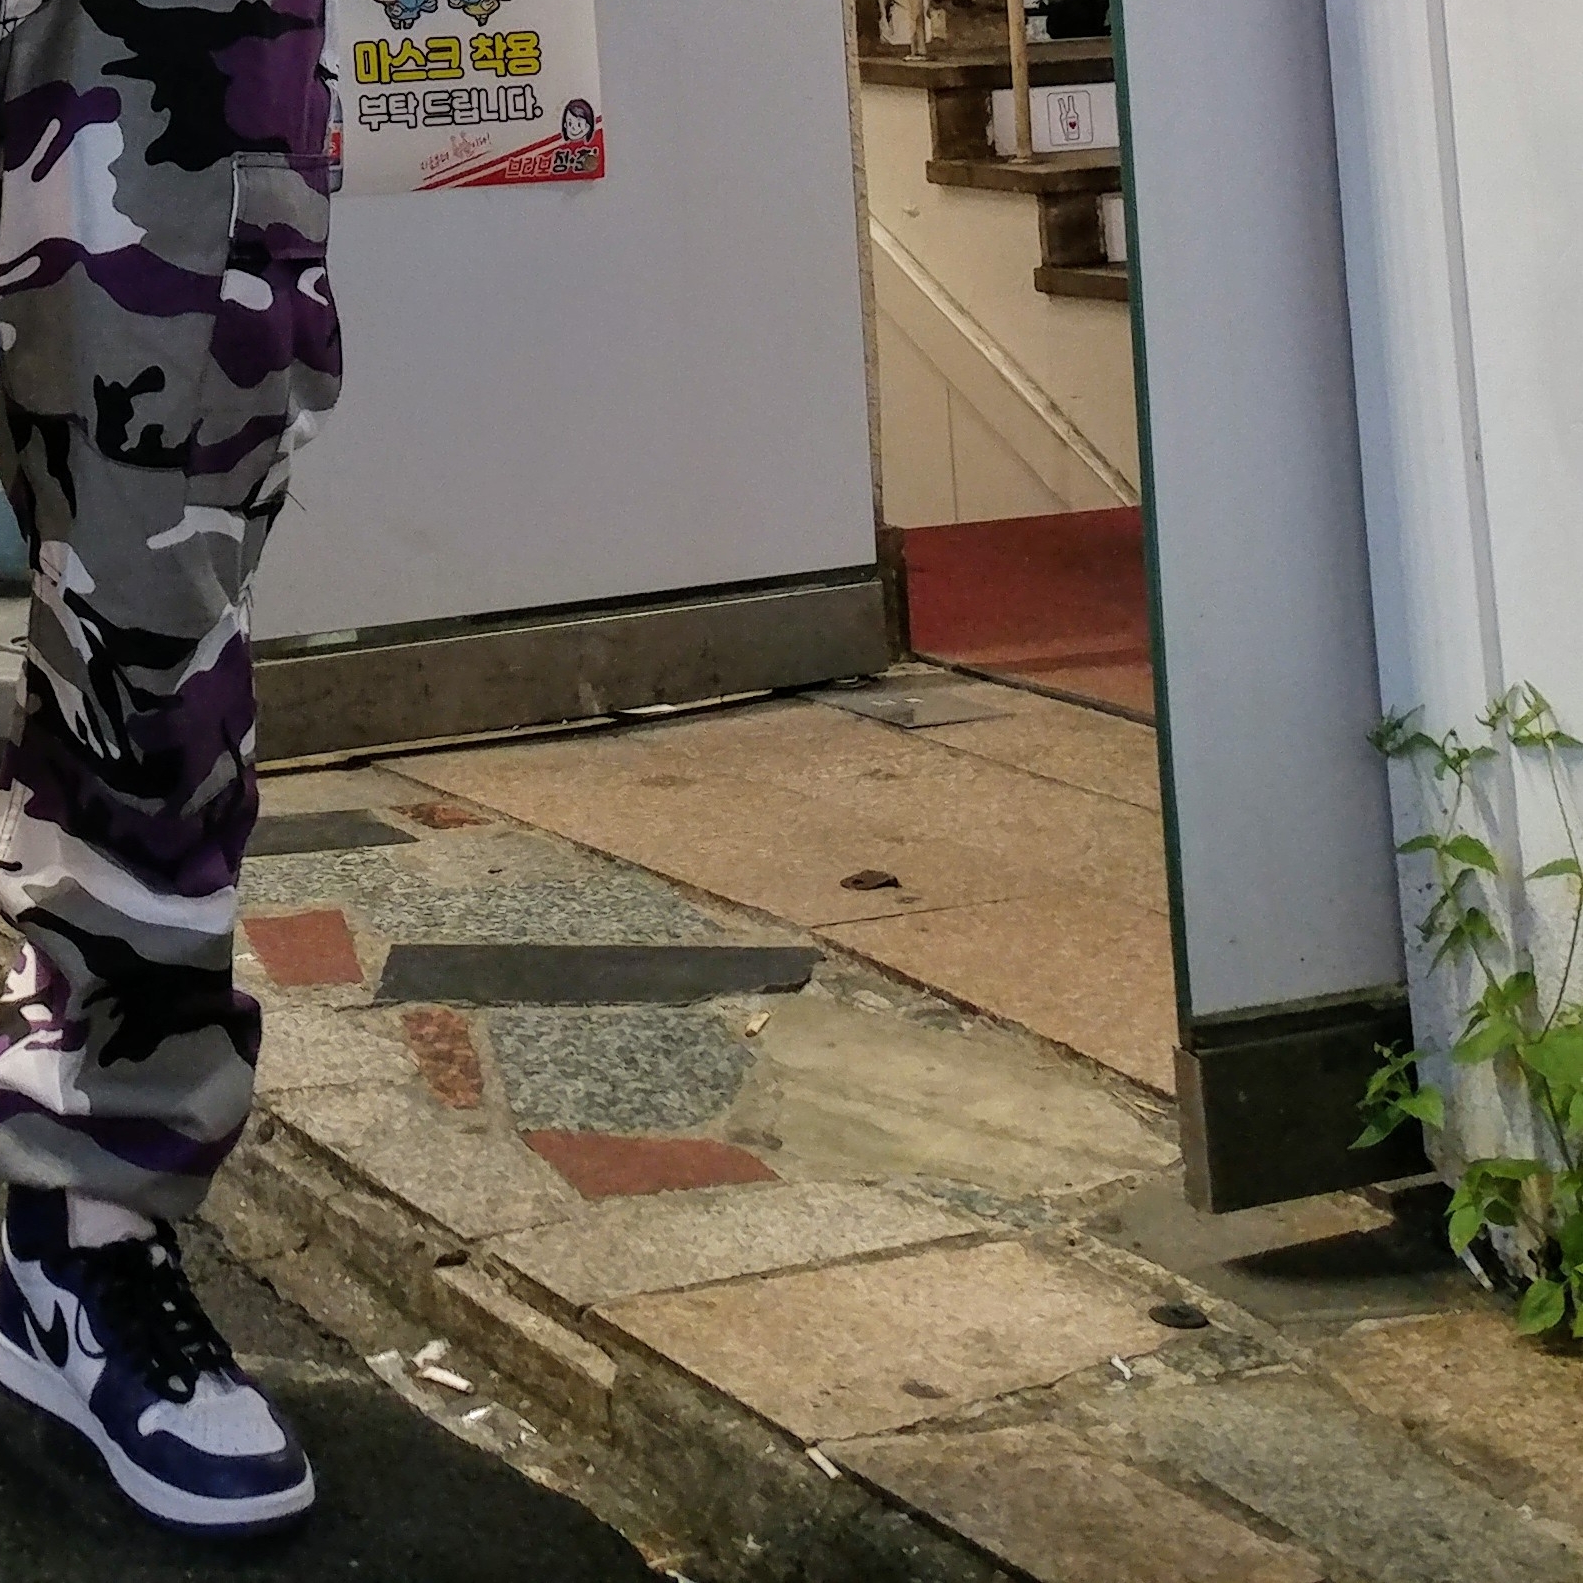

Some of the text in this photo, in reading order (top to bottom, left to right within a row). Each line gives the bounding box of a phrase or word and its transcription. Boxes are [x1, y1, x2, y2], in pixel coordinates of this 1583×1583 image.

[354, 30, 542, 84] 마스크 착용
[358, 84, 544, 132] 부탁 드립니다.
